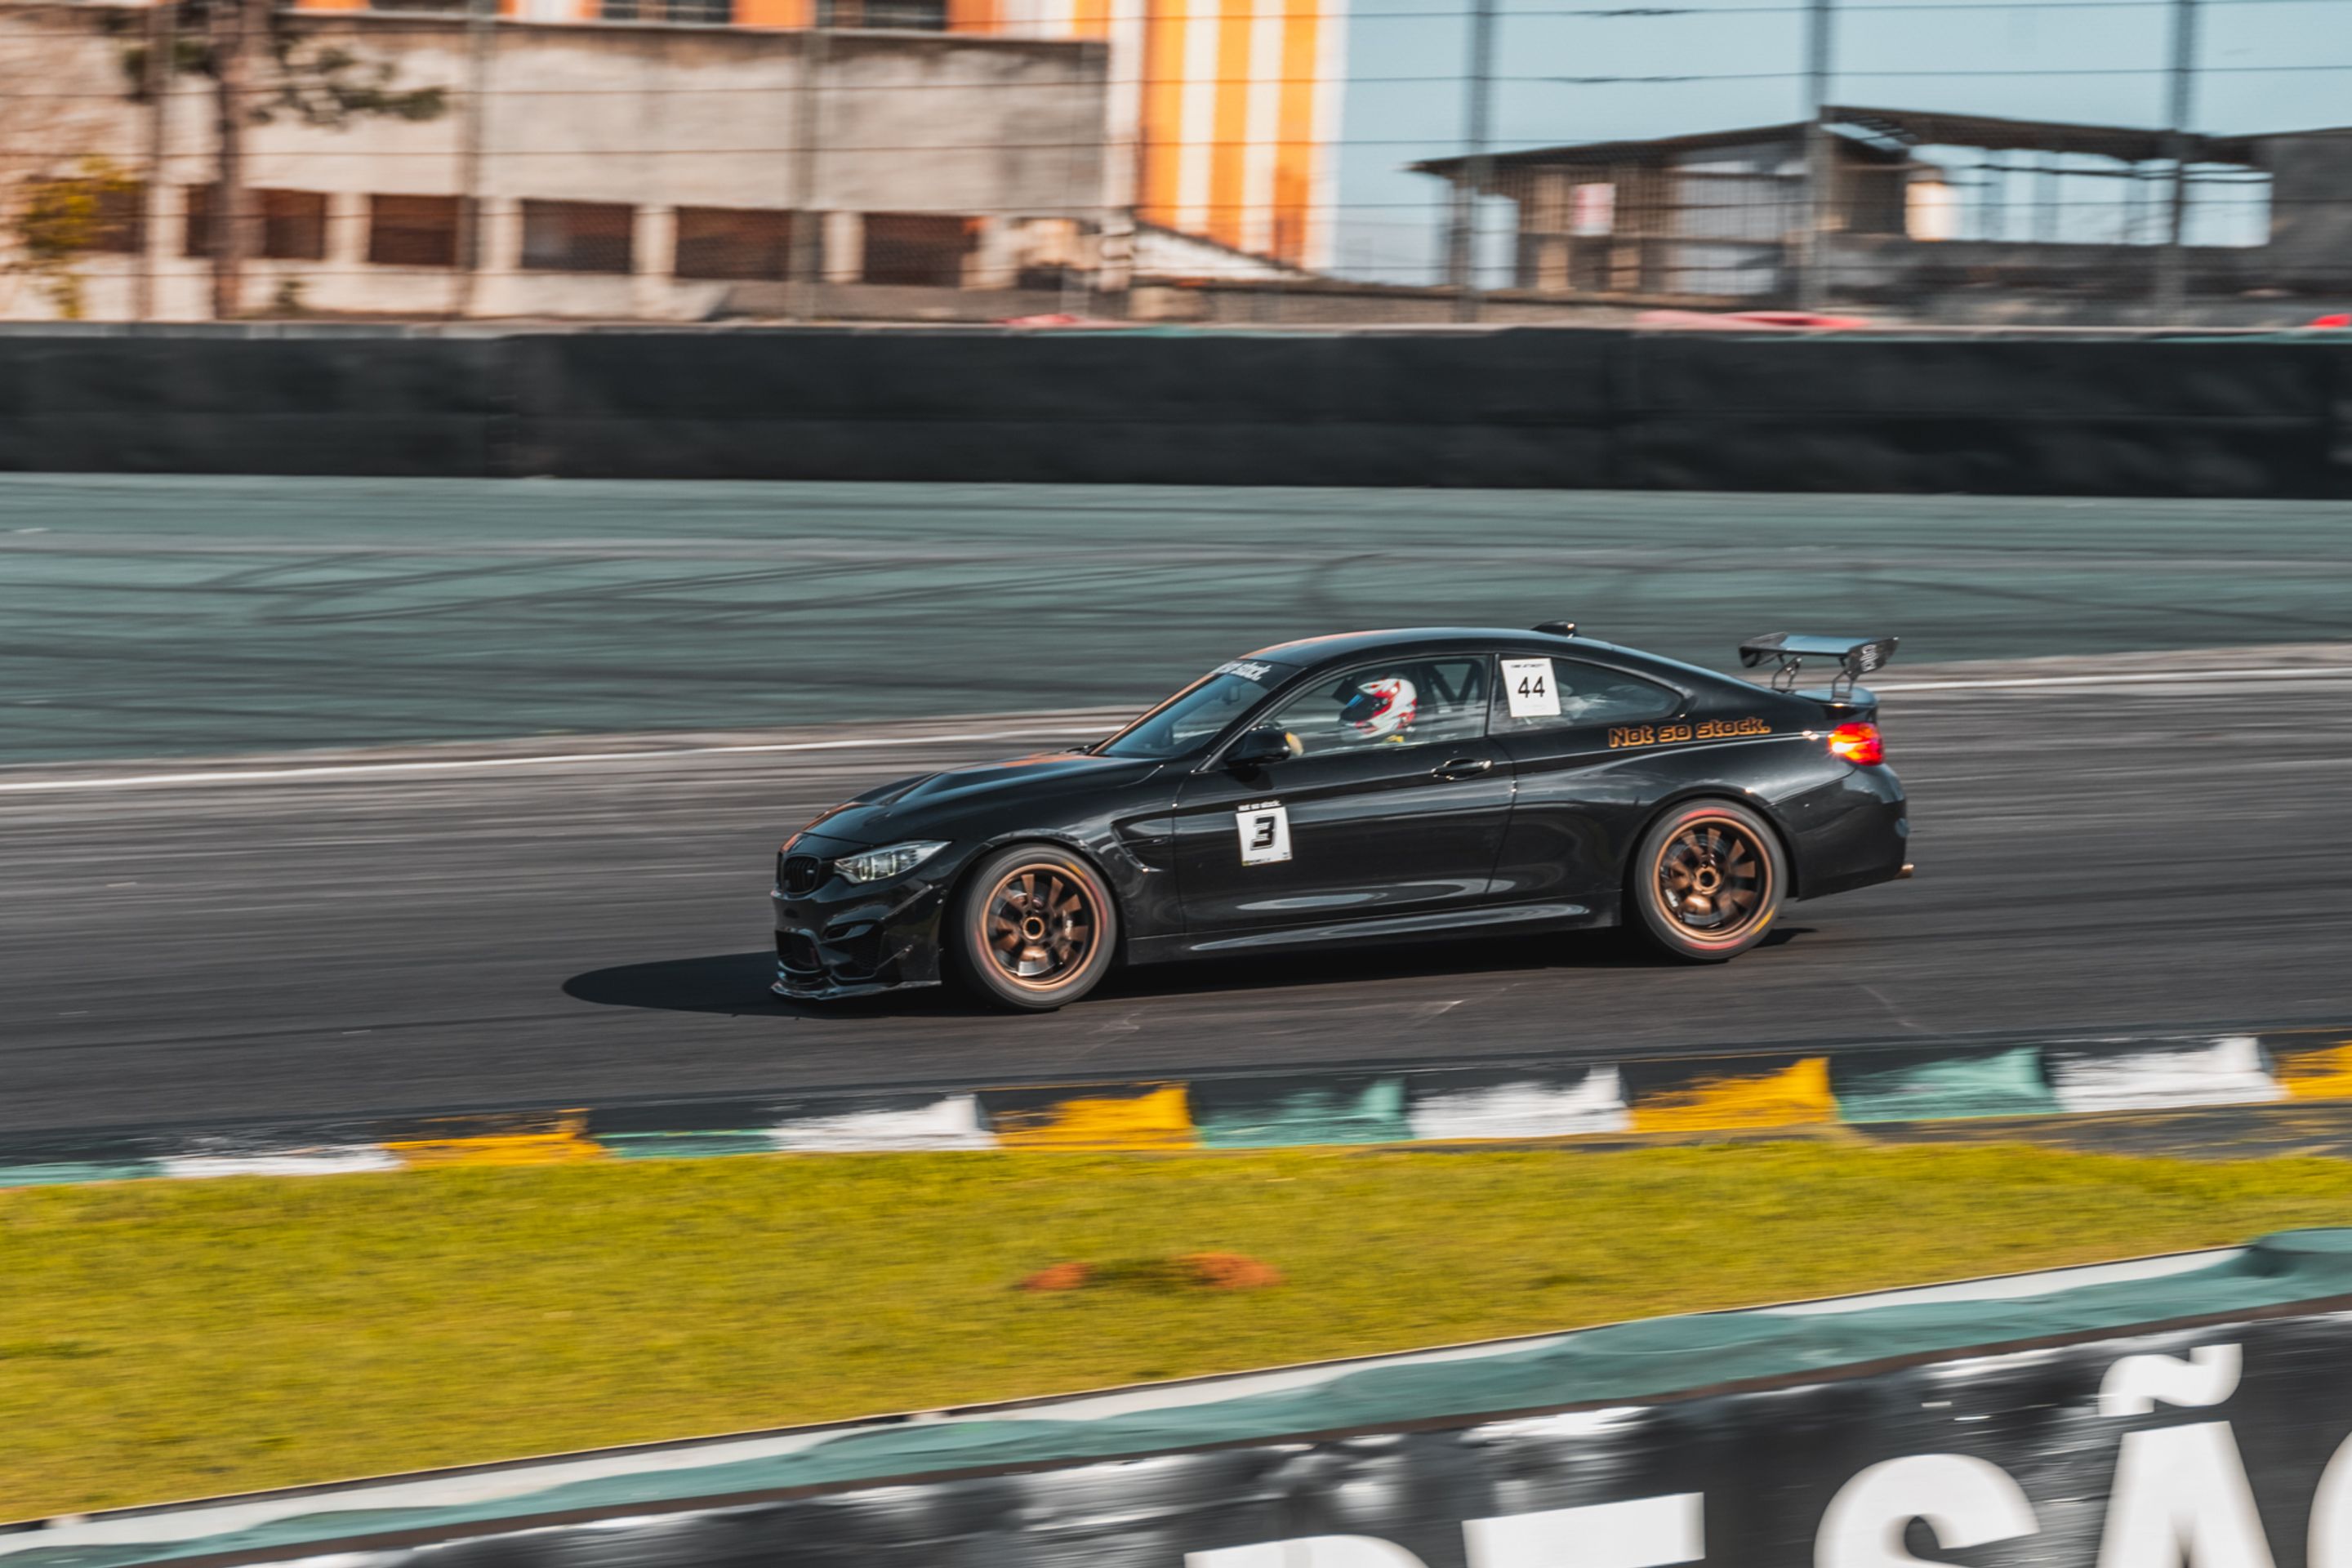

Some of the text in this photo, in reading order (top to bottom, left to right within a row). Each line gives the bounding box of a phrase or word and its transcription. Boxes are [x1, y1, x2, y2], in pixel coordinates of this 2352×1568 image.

[1517, 675, 1545, 698] 44
[1609, 717, 1771, 747] Not so stock.
[1250, 813, 1276, 851] 3
